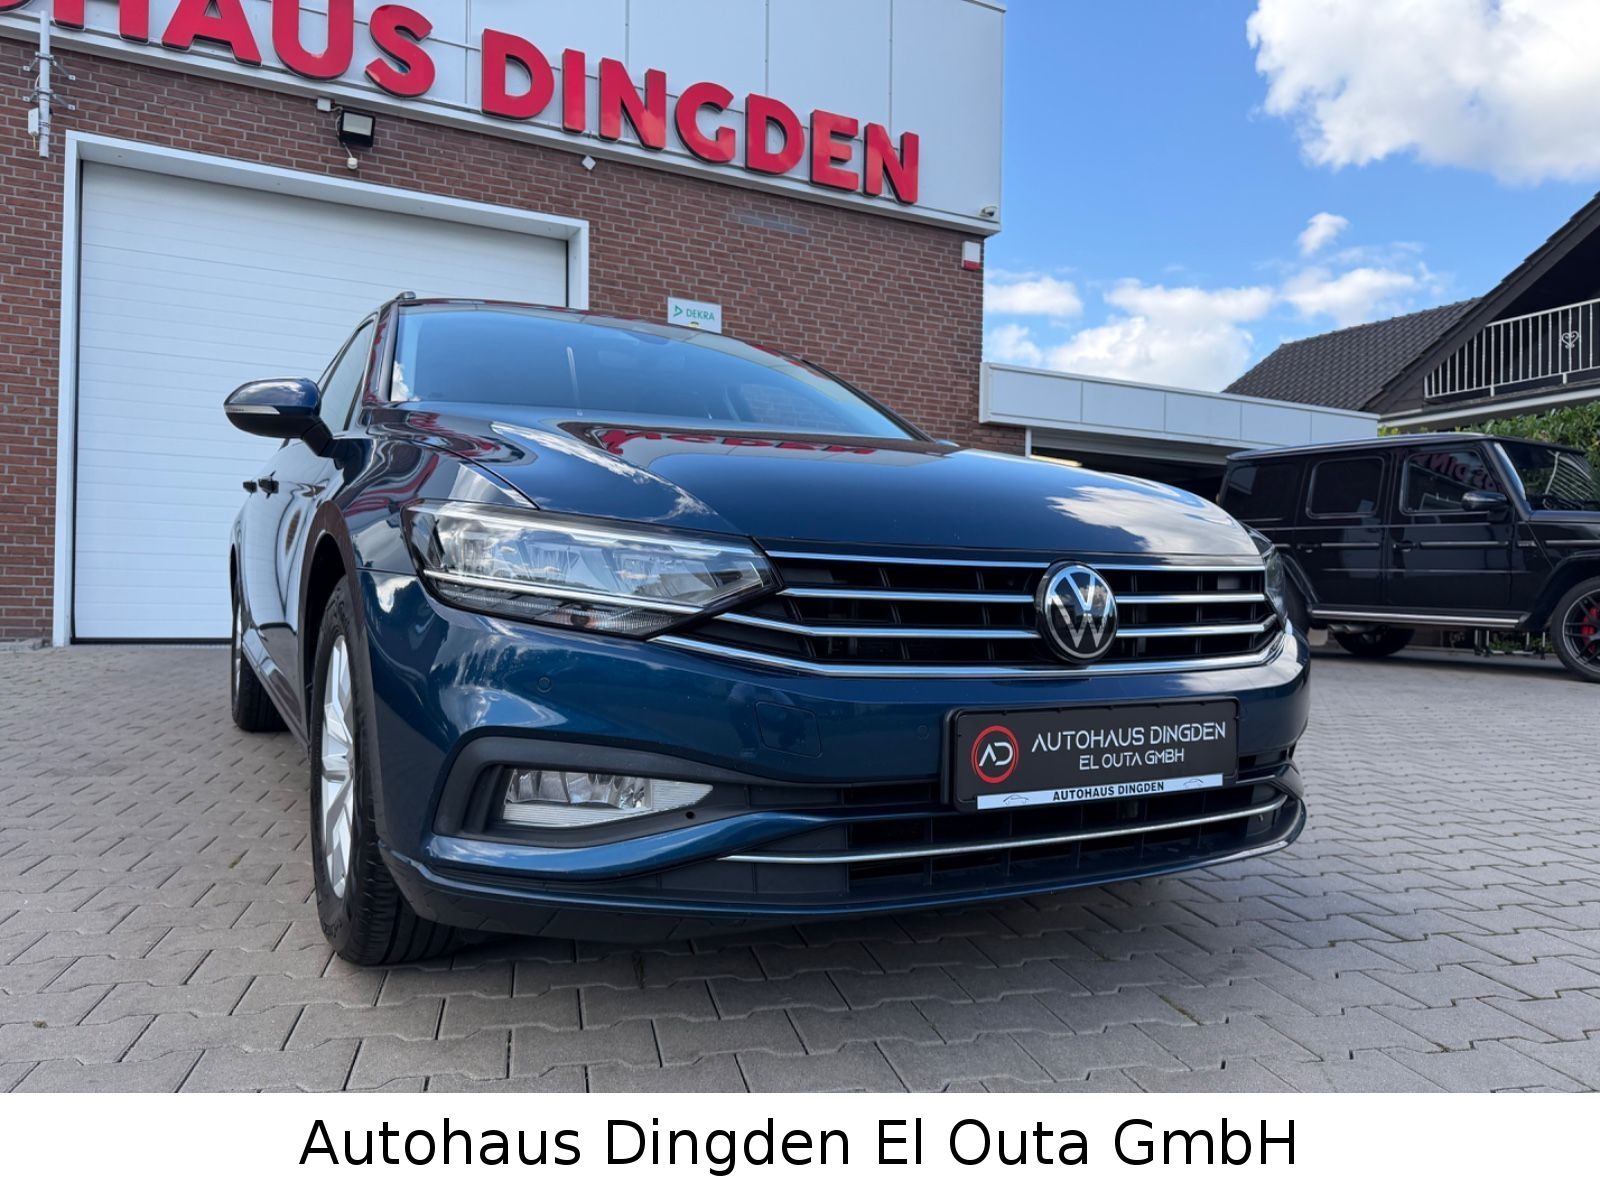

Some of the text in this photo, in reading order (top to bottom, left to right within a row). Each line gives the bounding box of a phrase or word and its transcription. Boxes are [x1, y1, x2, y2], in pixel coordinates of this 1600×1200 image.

[0, 0, 919, 204] AUS DINGDEN
[686, 308, 715, 321] DEKRA
[1047, 567, 1115, 655] VW
[1031, 721, 1226, 753] AUTOHAUS DINGDEN
[1079, 748, 1184, 770] EL OUTA GMBH
[1052, 781, 1164, 801] AUTOHAUS DINGDEN
